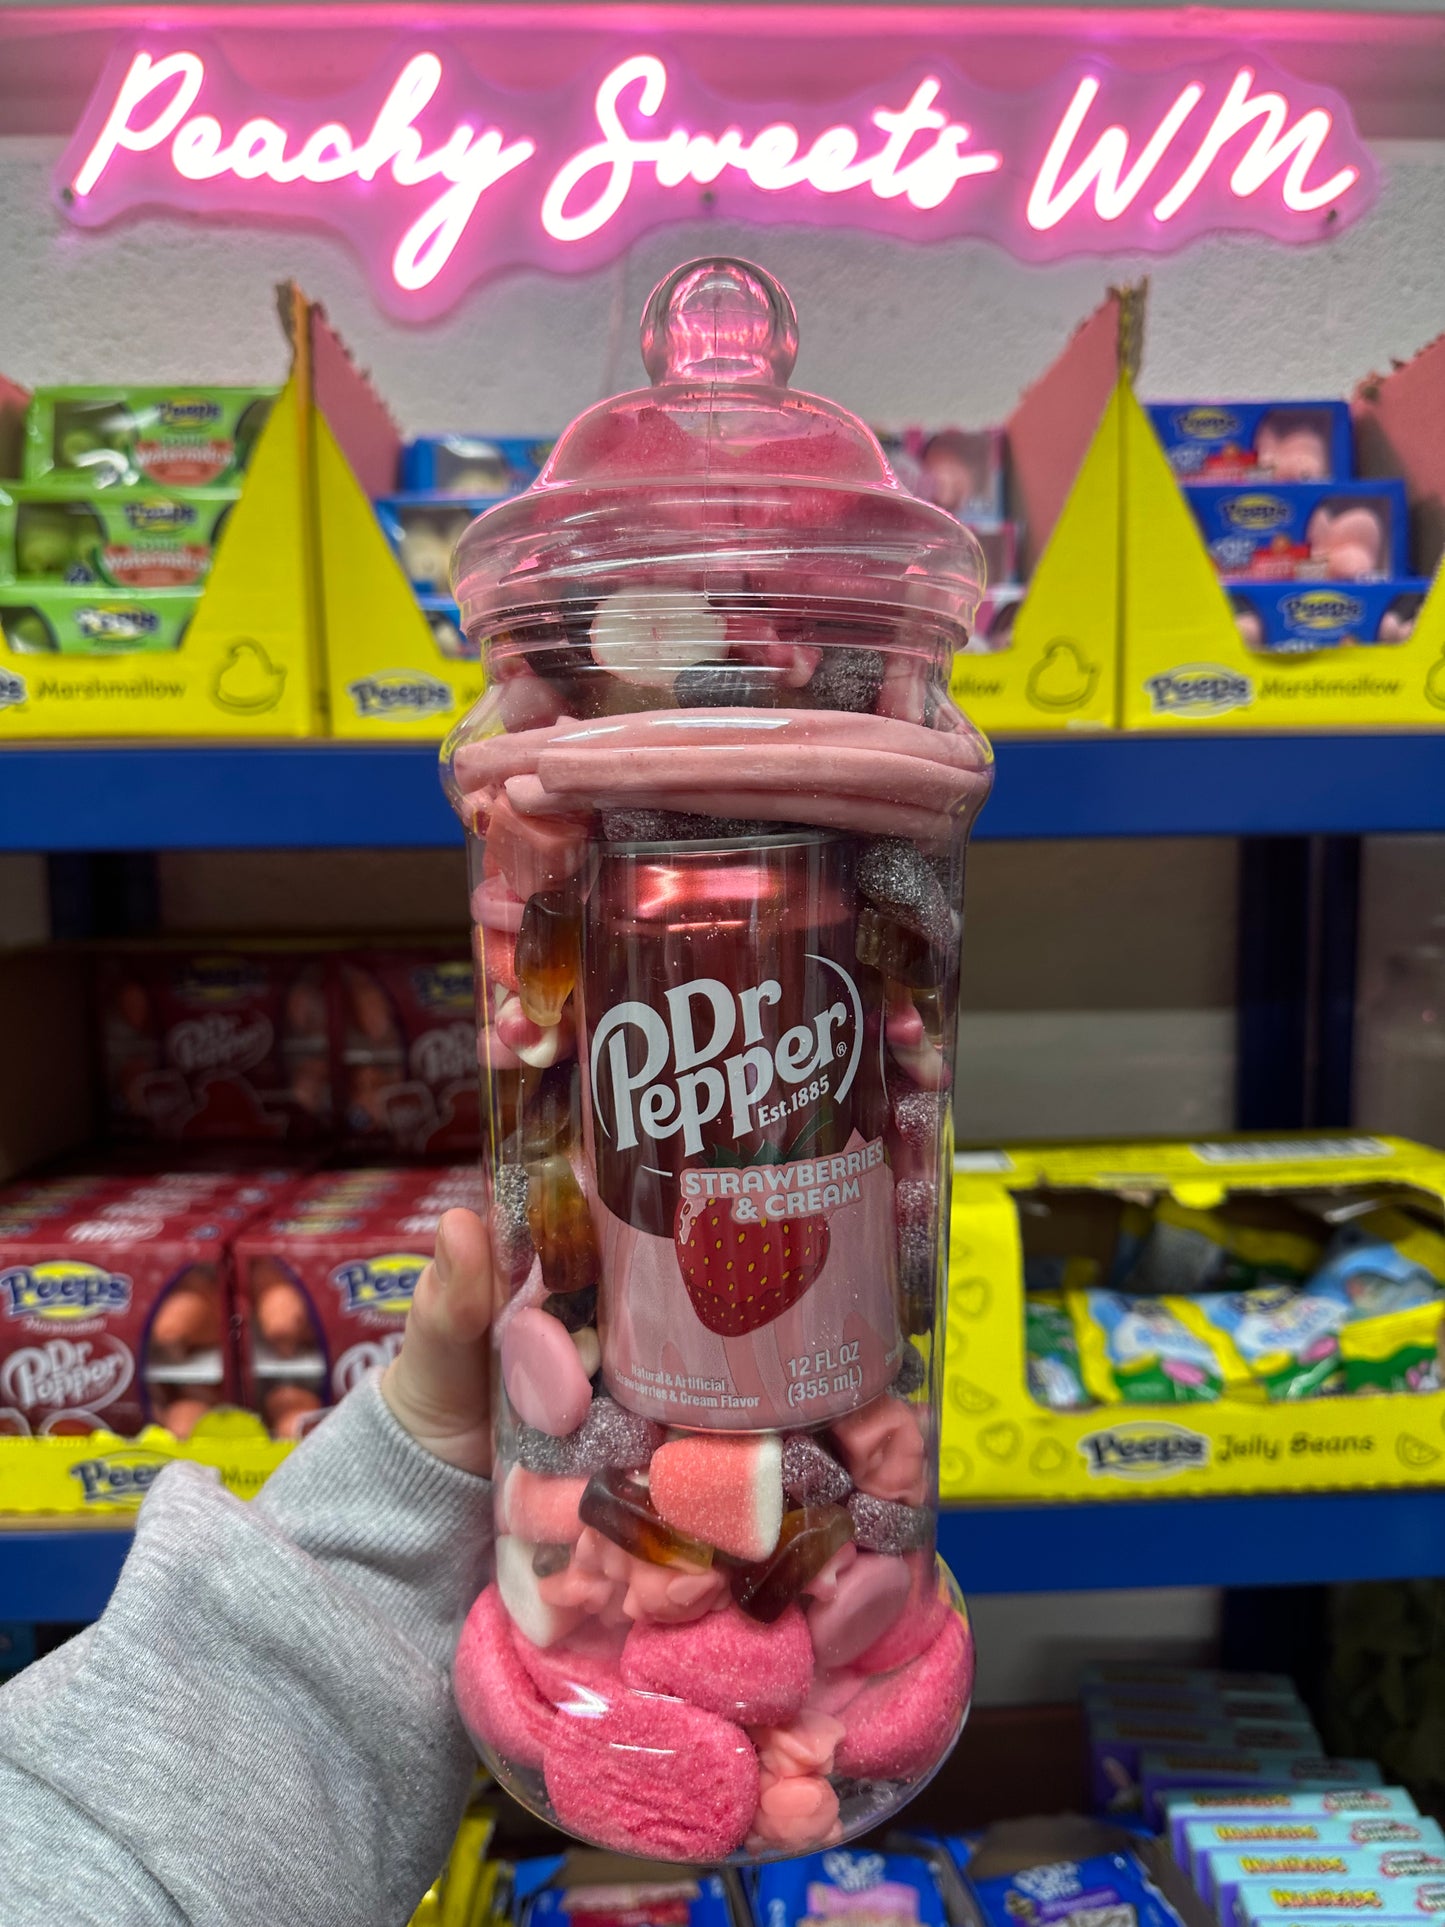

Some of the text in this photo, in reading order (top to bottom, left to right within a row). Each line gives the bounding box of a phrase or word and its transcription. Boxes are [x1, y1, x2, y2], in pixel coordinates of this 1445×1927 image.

[75, 51, 535, 290] Peachy
[541, 55, 1001, 241] Sweets
[664, 978, 782, 1075] Dr
[590, 1000, 848, 1158] Pepper
[685, 1143, 885, 1196] STRAWBERRIES
[734, 1176, 860, 1220] & CREAM
[0, 1267, 128, 1315] Peeps
[337, 1263, 425, 1308] Pee
[631, 1363, 664, 1385] Natural
[674, 1374, 726, 1392] Artificial
[787, 1356, 811, 1378] 12
[815, 1349, 837, 1373] FL
[839, 1341, 861, 1365] OZ
[679, 1390, 718, 1408] Cream
[720, 1393, 760, 1409] Flavor
[787, 1365, 863, 1408] (355 mL)
[1081, 1431, 1377, 1471] Peeps Jelly Beans
[71, 1460, 160, 1500] Pee
